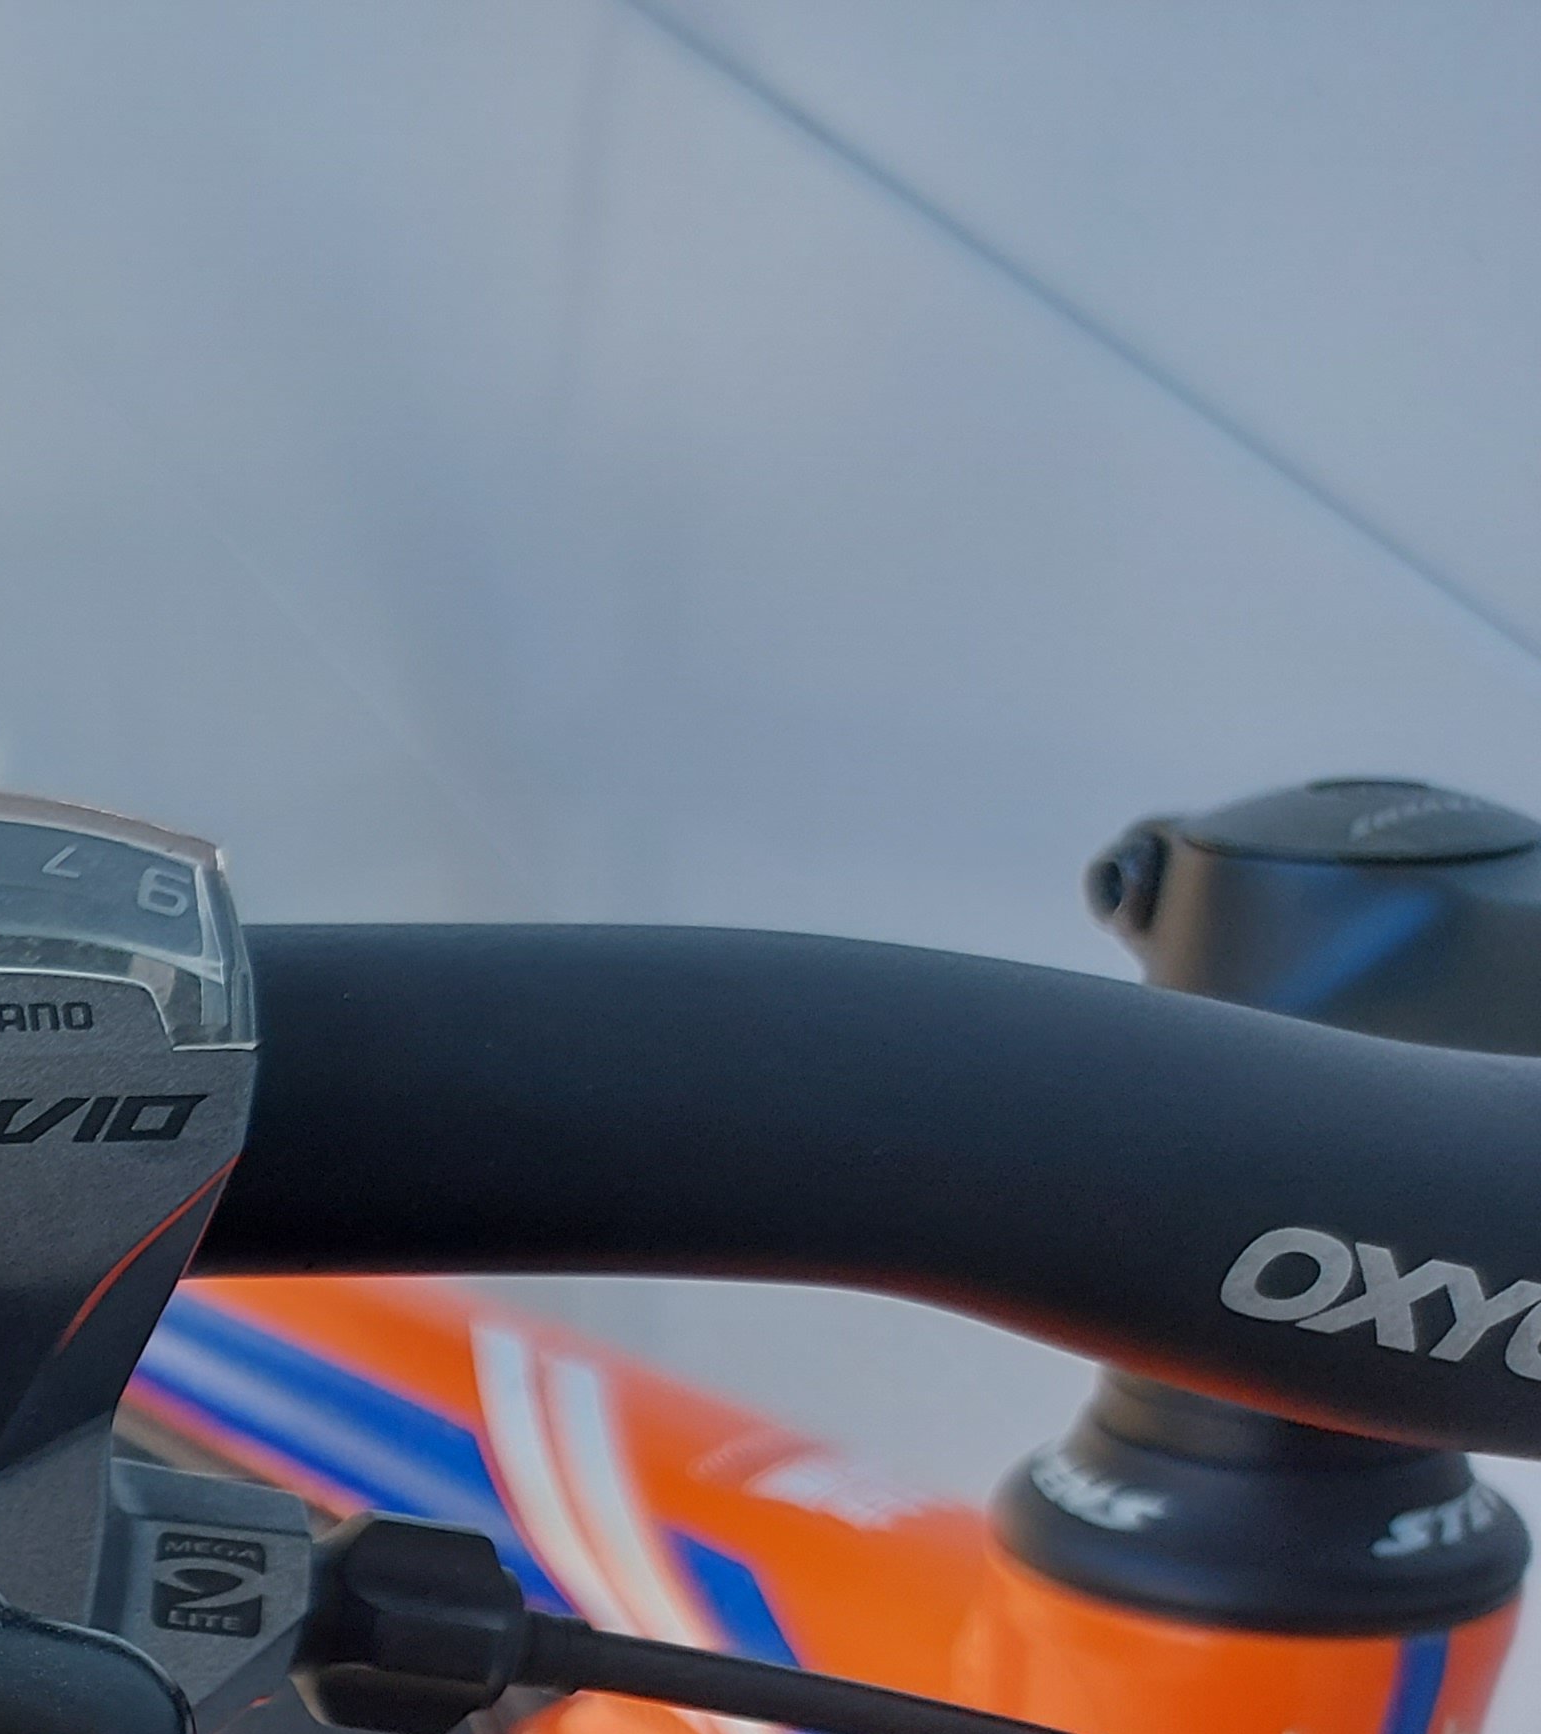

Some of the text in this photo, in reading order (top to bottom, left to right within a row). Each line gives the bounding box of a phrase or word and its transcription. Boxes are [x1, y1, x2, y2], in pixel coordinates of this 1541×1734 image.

[40, 844, 83, 879] 7
[136, 865, 193, 917] 9
[1220, 1226, 1541, 1382] OXY
[167, 1610, 243, 1632] LITE
